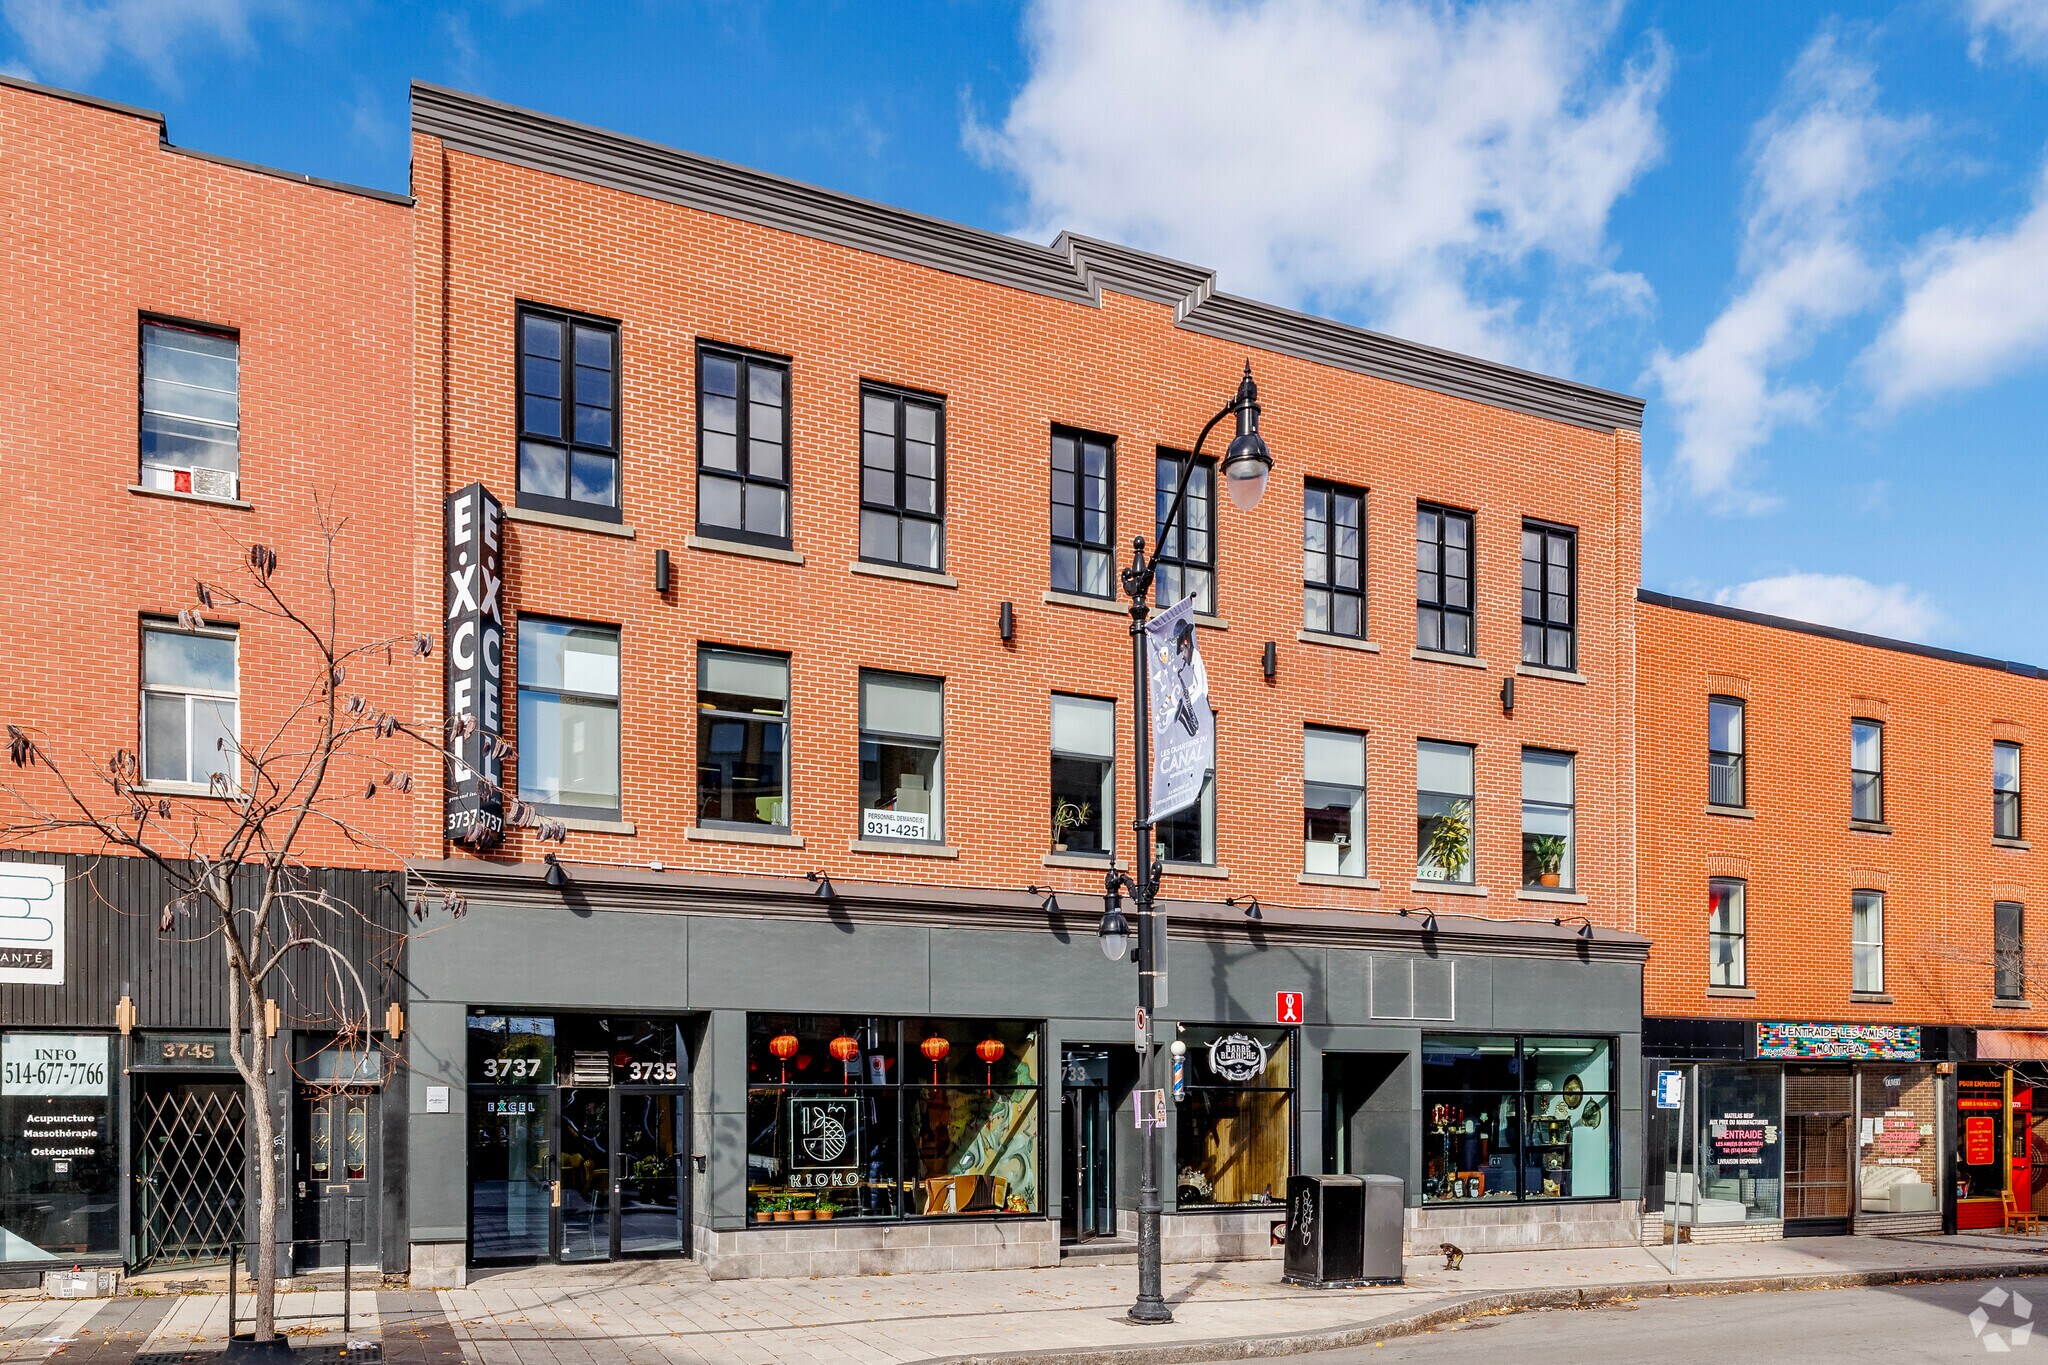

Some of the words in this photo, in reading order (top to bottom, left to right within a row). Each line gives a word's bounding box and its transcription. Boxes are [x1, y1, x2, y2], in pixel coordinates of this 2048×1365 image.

[1161, 748, 1171, 758] LES
[1171, 737, 1199, 754] QUARTIERS
[1199, 734, 1208, 744] DU
[1160, 744, 1204, 774] CANAL
[448, 808, 478, 830] 3737
[480, 809, 502, 833] 3737
[867, 812, 896, 822] PERSONNEL
[867, 821, 925, 838] 931-4251
[1419, 867, 1443, 878] XCEL
[0, 951, 43, 964] ANTÉ
[1839, 1027, 1860, 1039] LES
[1861, 1028, 1885, 1039] AMIS
[1886, 1029, 1901, 1039] DE
[35, 1048, 77, 1061] INFO
[162, 1042, 215, 1059] 3745
[1225, 1044, 1251, 1053] BARBE
[1815, 1040, 1867, 1055] MONTRÉAL
[1220, 1051, 1257, 1060] BLANCHE
[5, 1062, 104, 1085] 514-677-7766
[484, 1058, 541, 1077] 3737
[629, 1061, 677, 1080] 3735
[1061, 1066, 1086, 1082] 733
[487, 1100, 535, 1112] EXCEL
[26, 1114, 95, 1125] Acupuncture
[23, 1129, 98, 1139] Massothérapie
[31, 1147, 95, 1157] Ostéopathie
[790, 1172, 859, 1188] KIOKO
